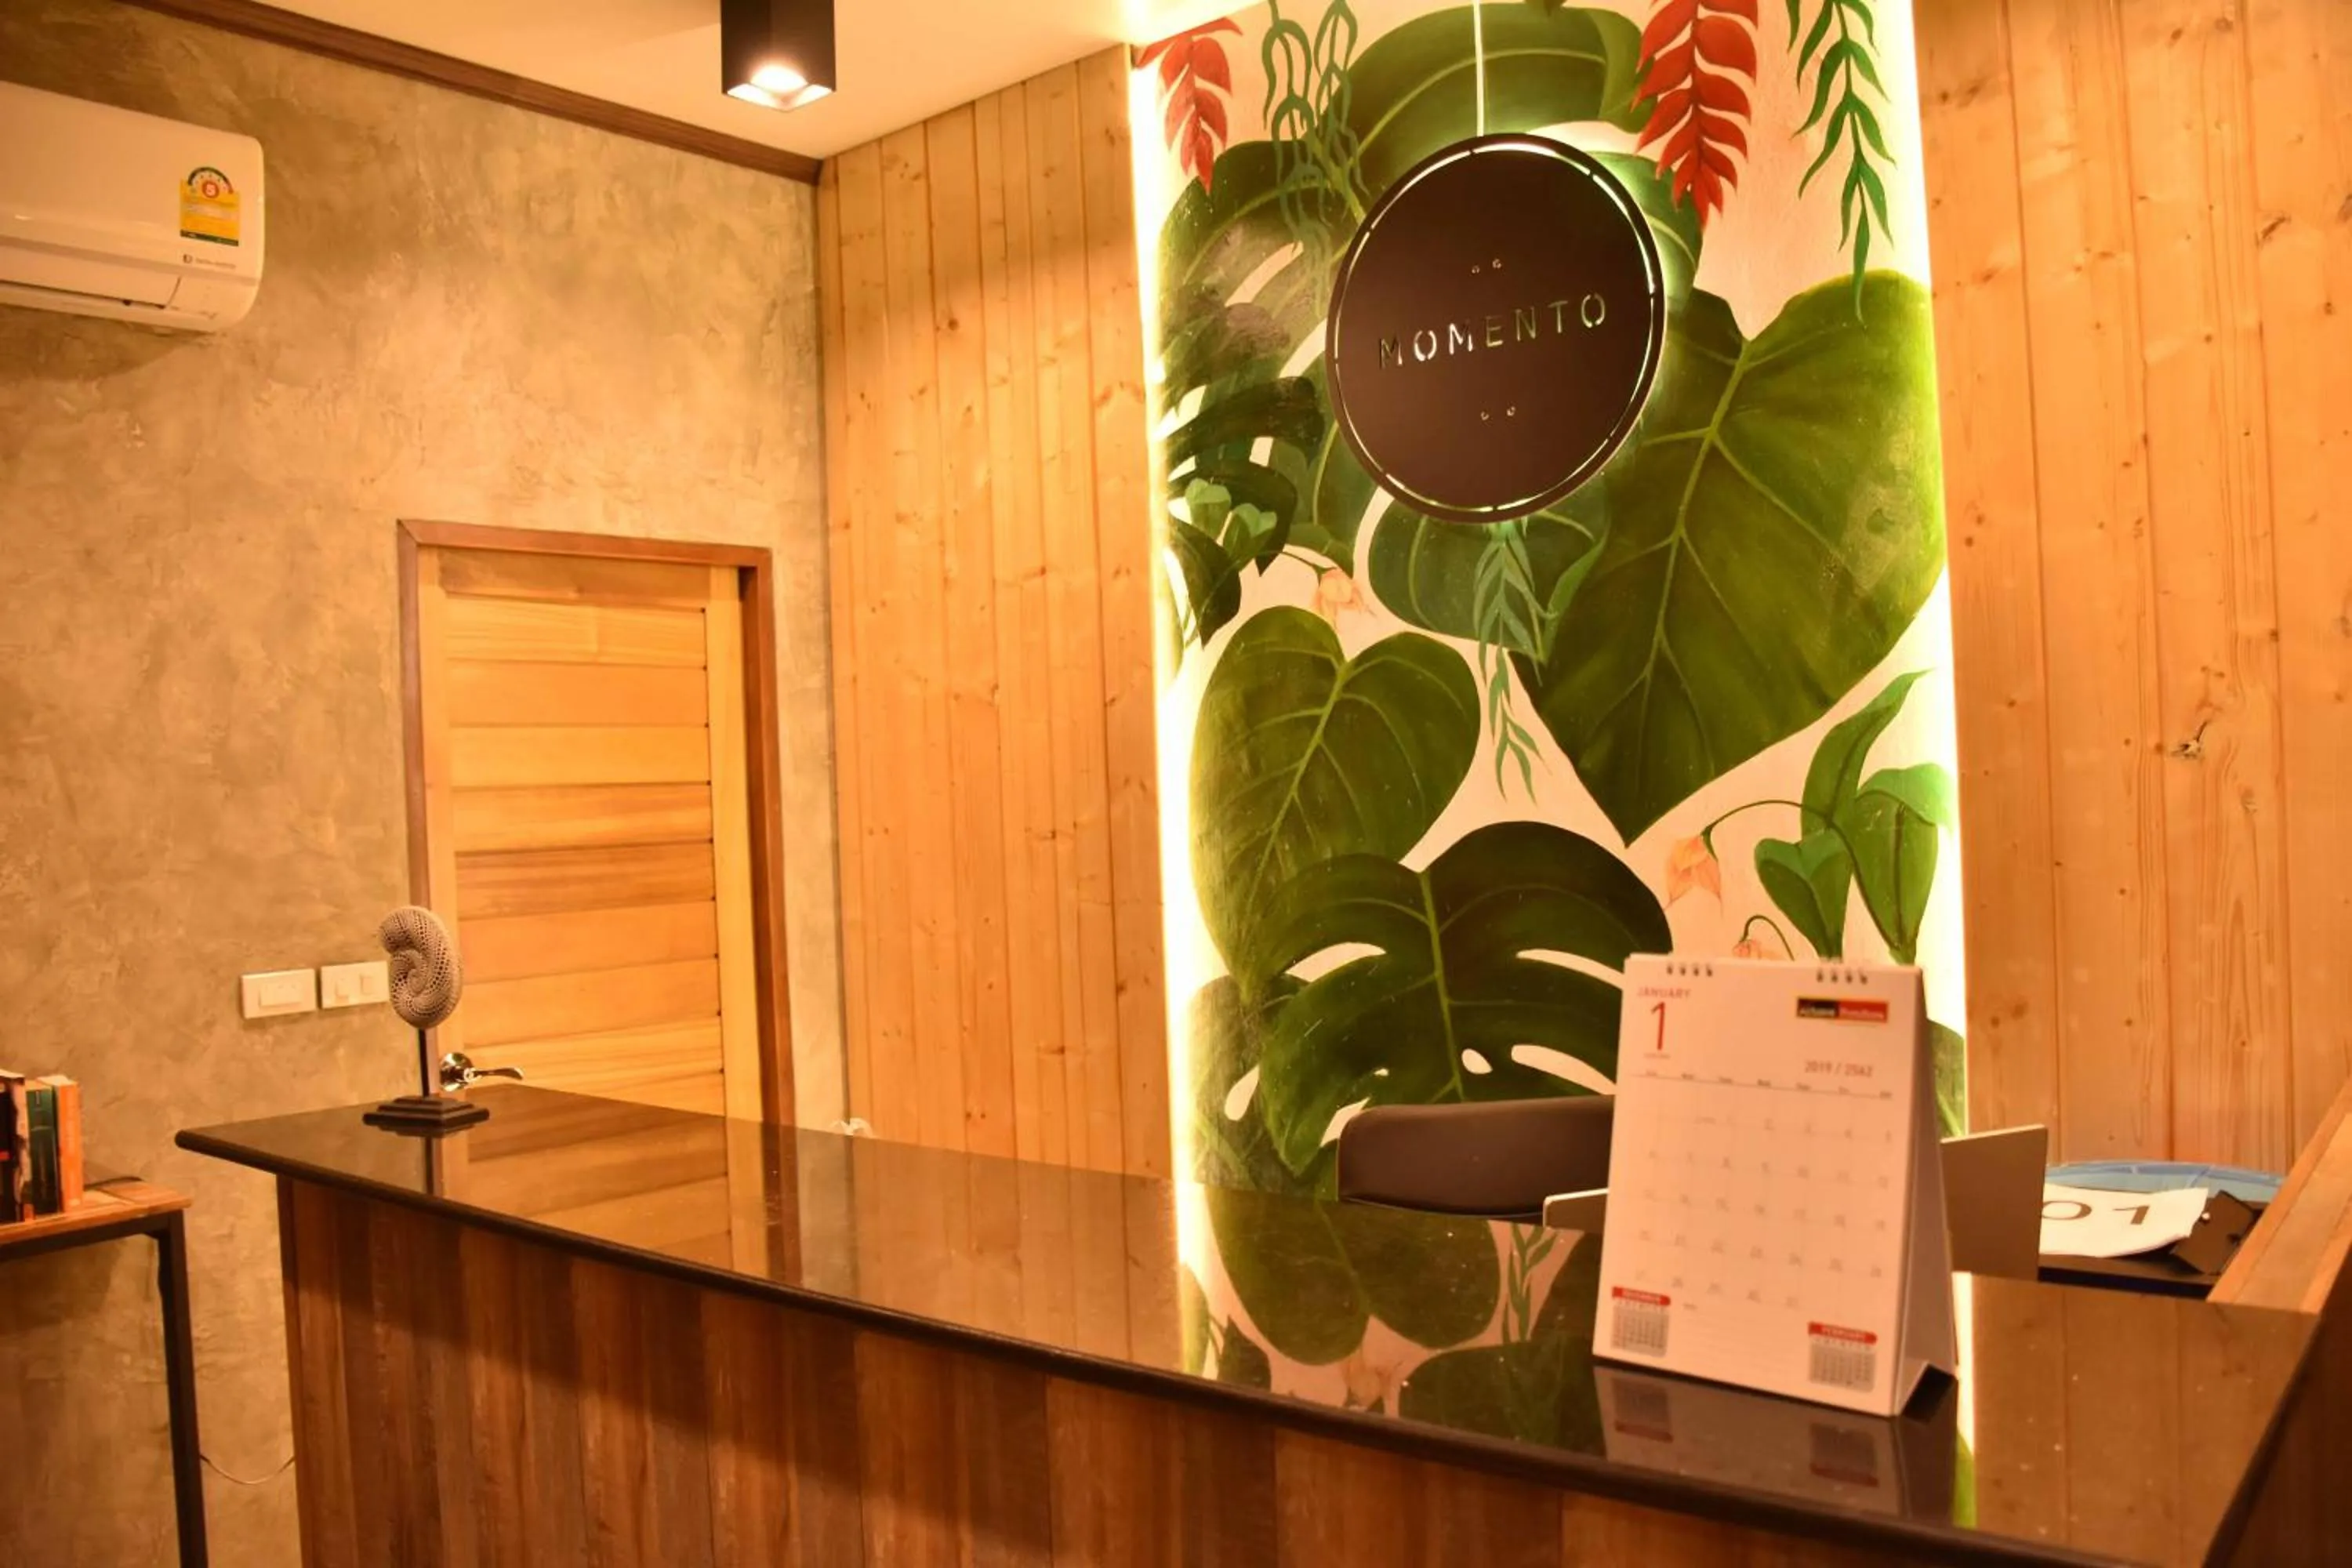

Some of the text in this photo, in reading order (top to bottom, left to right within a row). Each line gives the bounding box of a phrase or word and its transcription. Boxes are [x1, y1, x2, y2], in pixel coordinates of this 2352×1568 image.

[1378, 292, 1606, 369] MOMENTO
[1637, 986, 1691, 1000] JANUARY
[1650, 1001, 1665, 1051] 1
[1805, 1060, 1833, 1074] 2019
